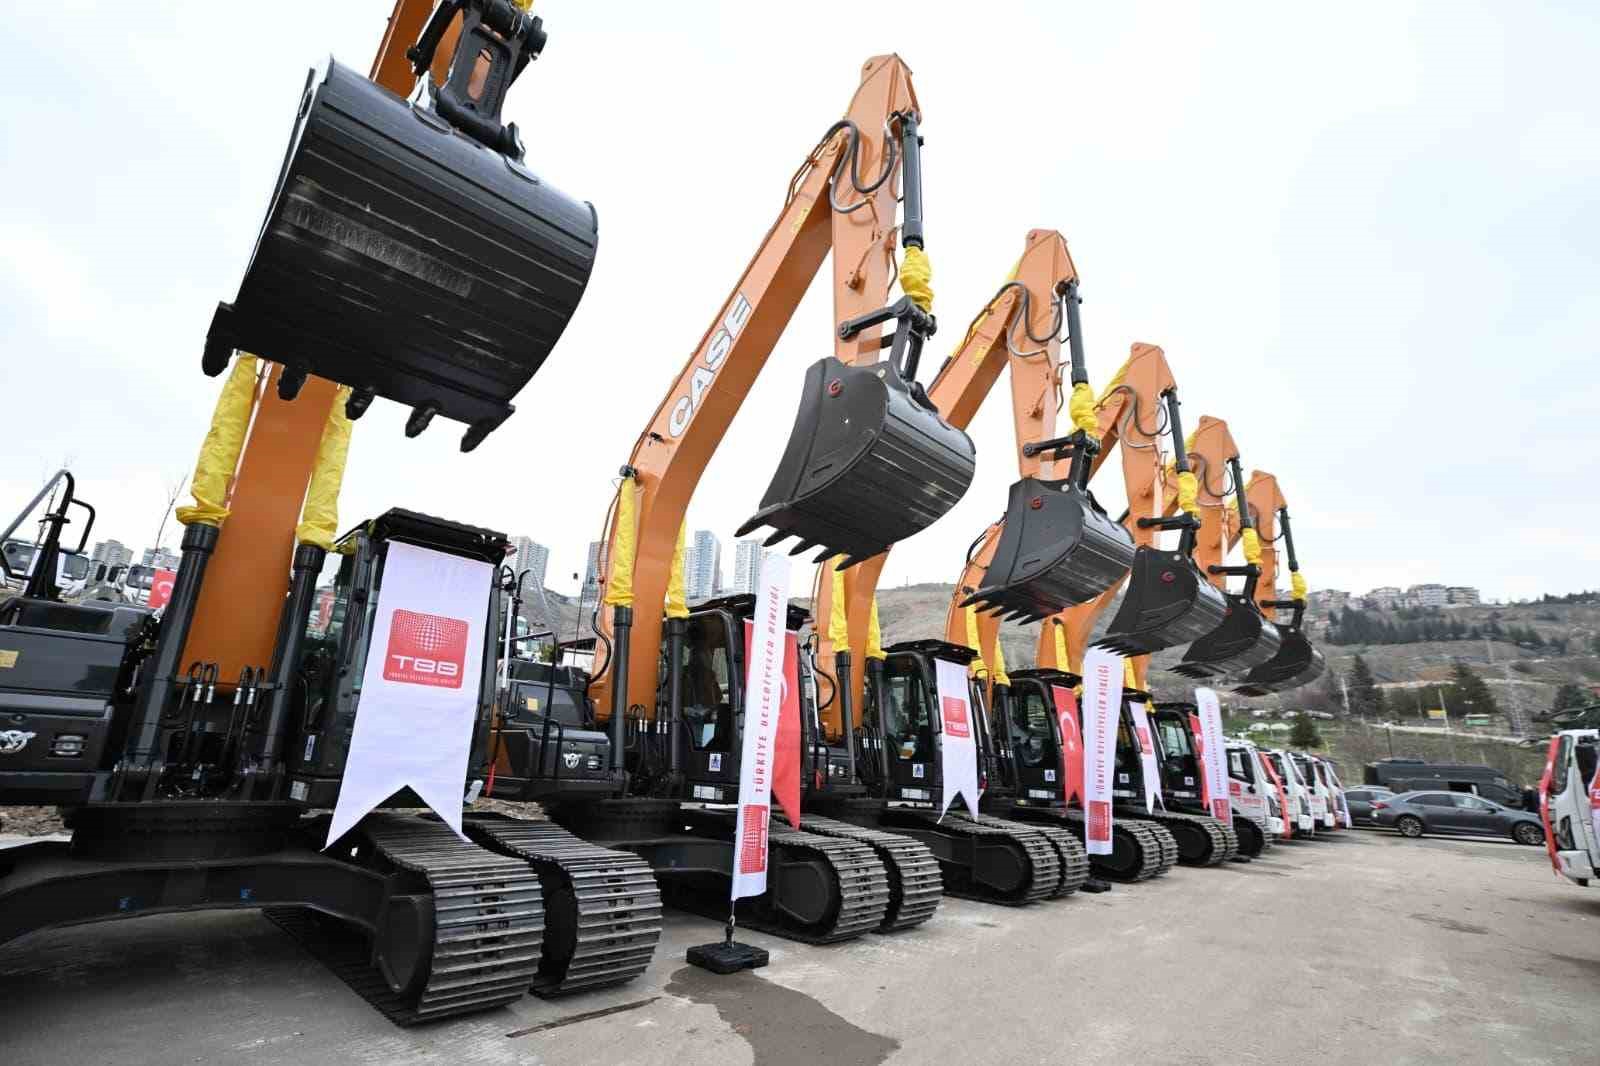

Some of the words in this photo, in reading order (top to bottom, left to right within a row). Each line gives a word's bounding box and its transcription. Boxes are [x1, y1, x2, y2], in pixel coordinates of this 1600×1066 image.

[669, 291, 752, 438] CASE
[391, 654, 459, 677] TBB
[754, 735, 767, 793] TÜRKİYE
